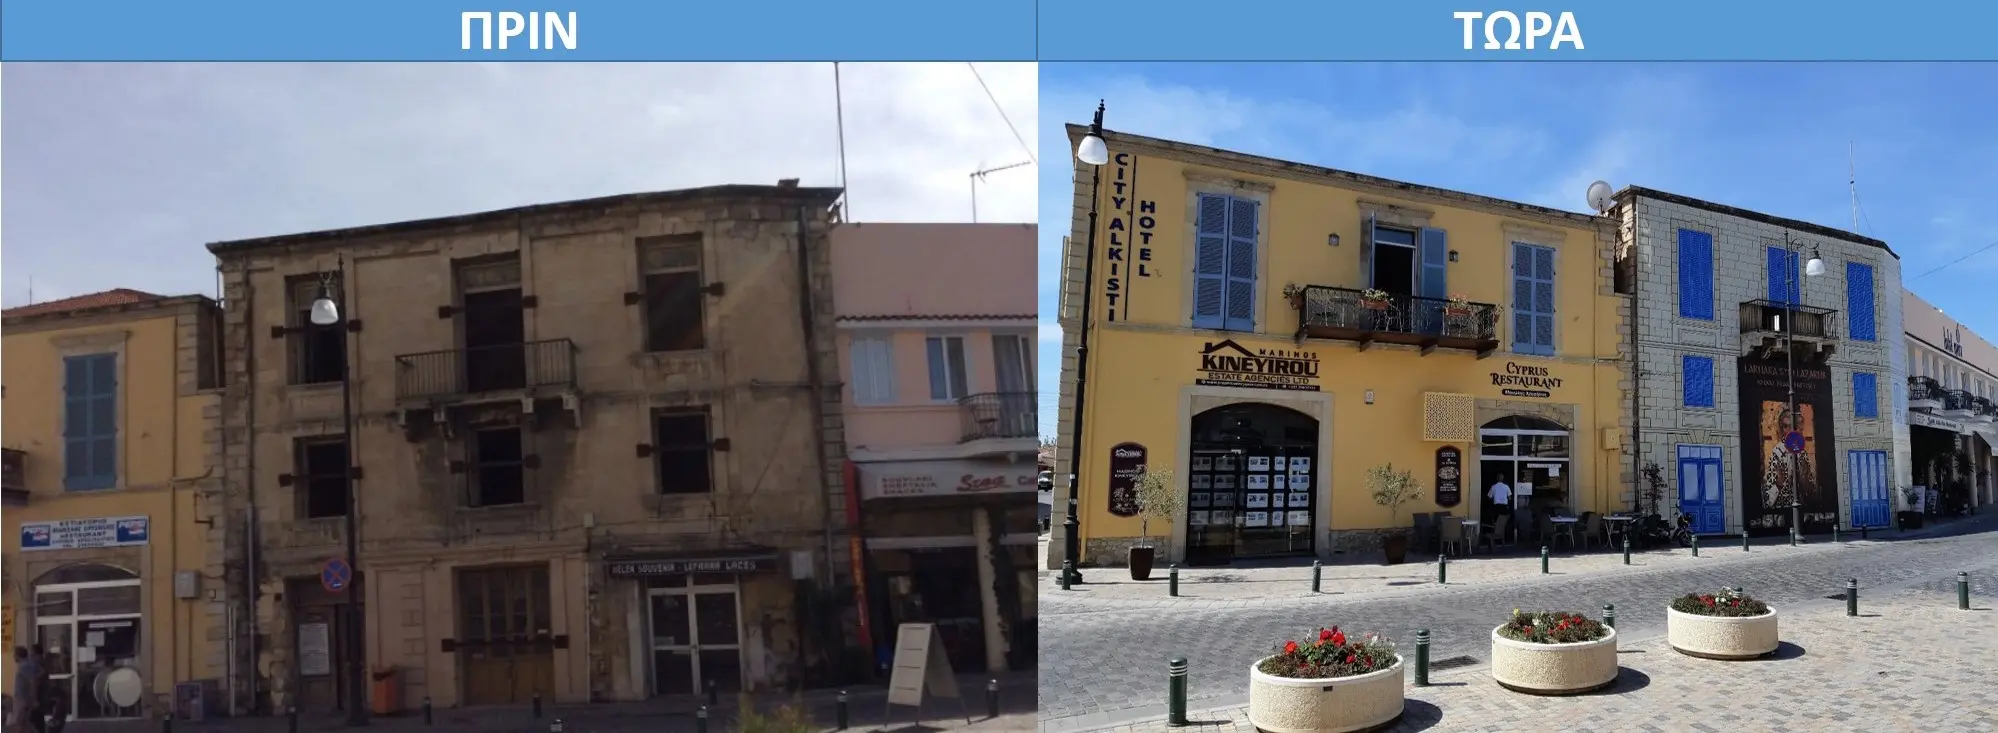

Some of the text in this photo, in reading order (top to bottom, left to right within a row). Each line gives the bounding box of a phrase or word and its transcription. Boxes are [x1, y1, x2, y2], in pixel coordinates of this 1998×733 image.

[1106, 153, 1129, 322] CITY ALKISTI
[1138, 200, 1156, 277] HOTEL
[1259, 348, 1317, 359] MARINOS
[1202, 354, 1319, 376] KINEYIROU
[1208, 372, 1242, 382] ESTATE
[1244, 374, 1291, 384] AGENCIES
[1293, 377, 1309, 385] LTD
[612, 564, 635, 574] HELEN
[638, 563, 675, 573] SOUVENIR
[725, 560, 756, 571] LACES
